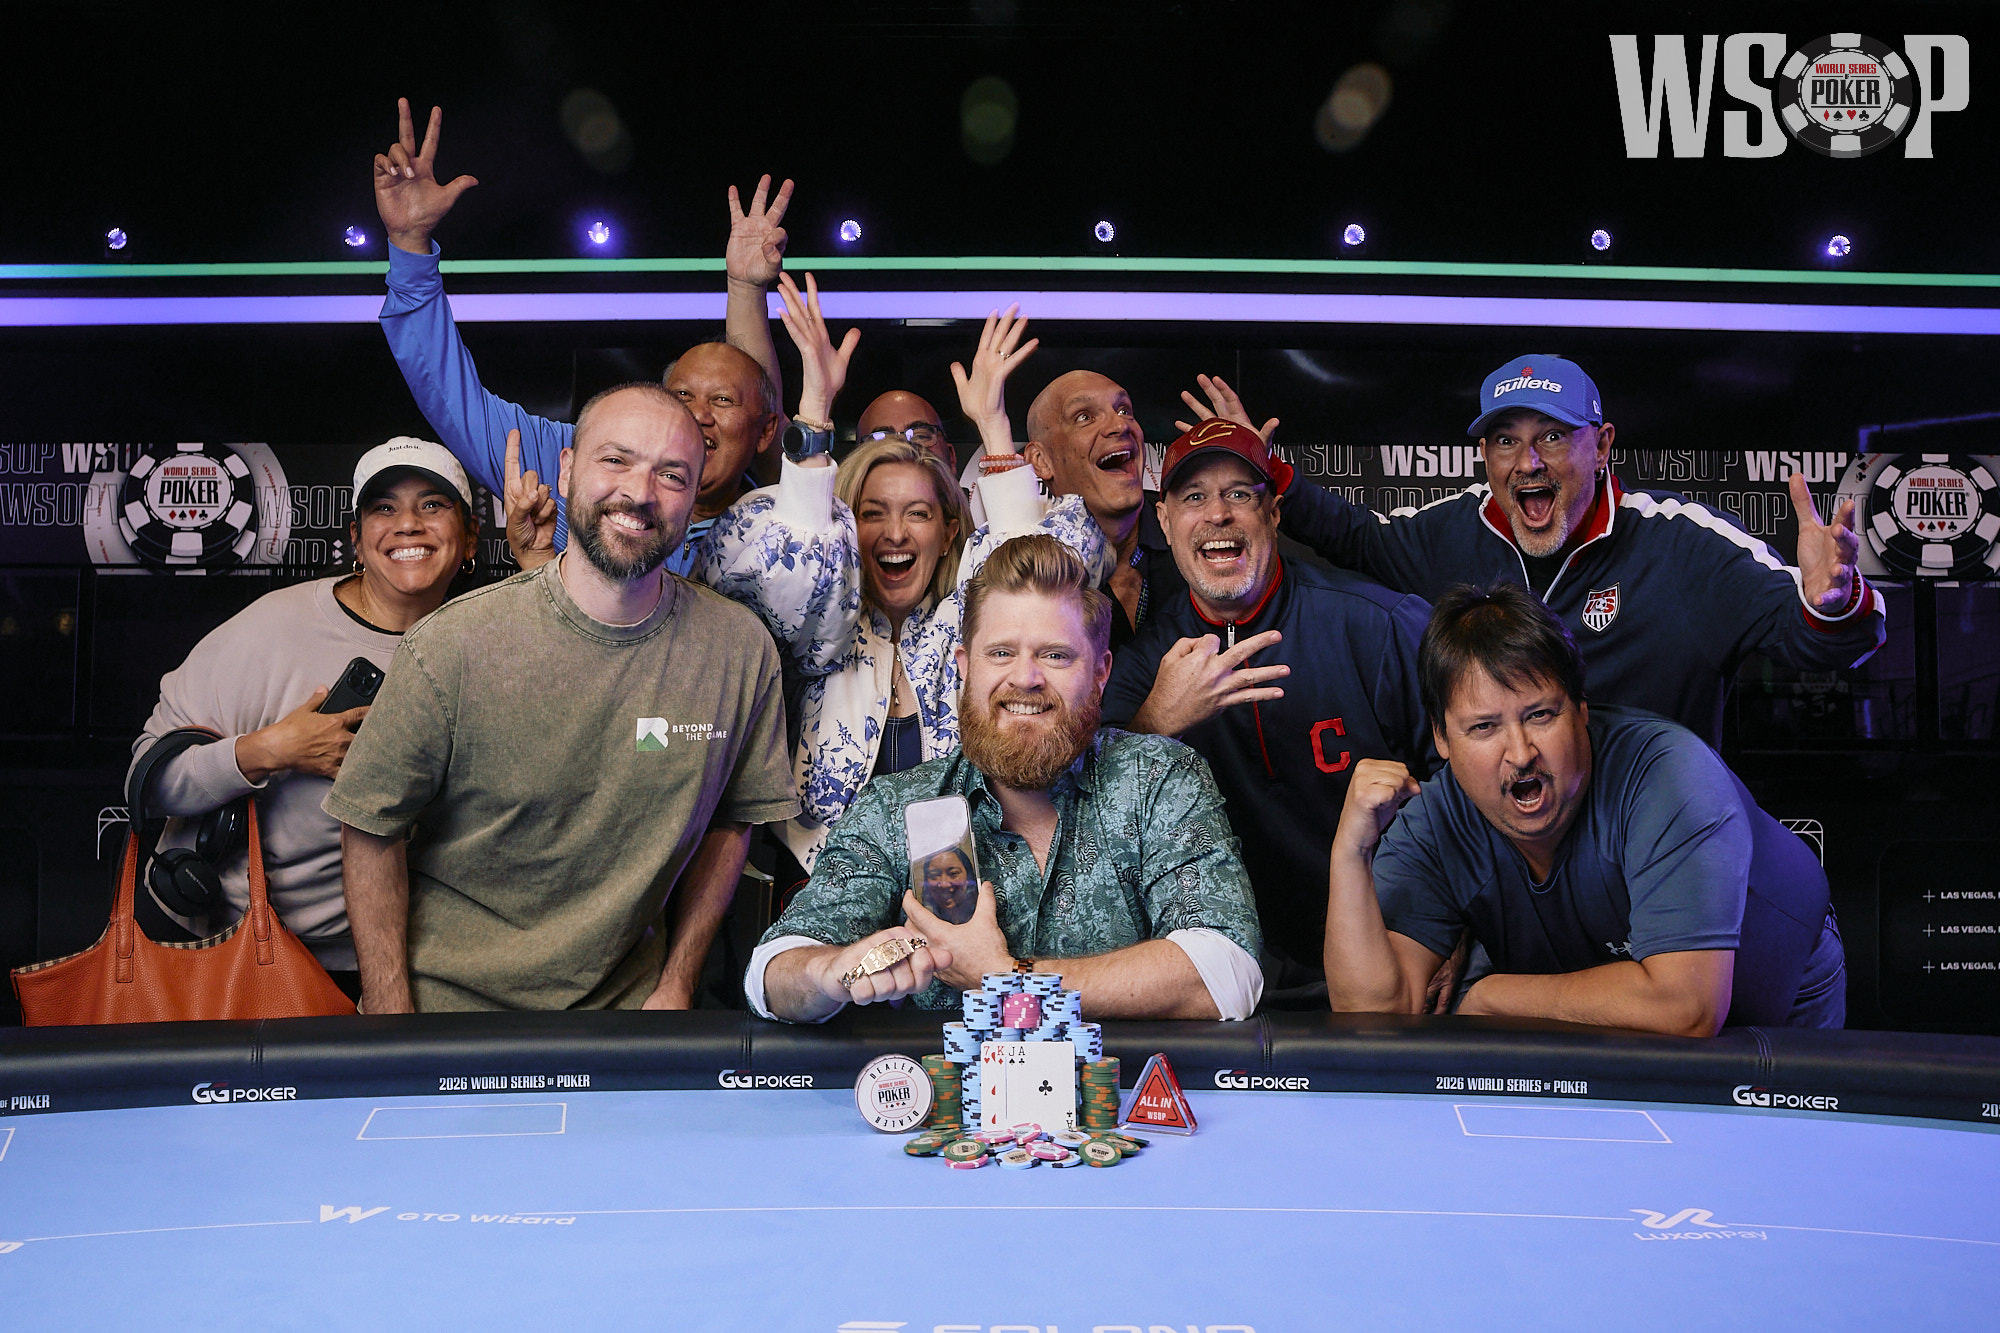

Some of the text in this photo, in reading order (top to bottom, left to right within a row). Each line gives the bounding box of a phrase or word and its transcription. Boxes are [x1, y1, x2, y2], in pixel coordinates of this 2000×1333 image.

[1494, 375, 1562, 398] bullets
[62, 442, 153, 474] WSO
[1380, 444, 1485, 478] WSOP
[1634, 449, 1739, 482] WSOP
[1744, 450, 1848, 482] WSOP
[164, 466, 217, 476] WORLD SERIES
[1909, 478, 1964, 488] WORLD SERIES
[159, 480, 218, 504] POKER
[0, 483, 101, 526] WSOP
[254, 485, 354, 529] WSOP
[1906, 492, 1968, 516] POKER
[672, 724, 714, 733] BEYOND
[686, 733, 702, 741] THE
[1310, 718, 1351, 774] C
[1961, 892, 1996, 900] VEGAS,
[1961, 926, 1996, 934] VEGAS,
[1961, 962, 1996, 971] VEGAS,
[984, 1046, 1025, 1056] 7 K J A
[870, 1062, 914, 1080] DEALER
[439, 1077, 467, 1090] 2026
[471, 1076, 507, 1090] WORLD
[510, 1075, 545, 1089] SERIES
[556, 1074, 590, 1088] POKER
[1436, 1077, 1464, 1090] 2026
[1467, 1078, 1504, 1091] WORLD
[1506, 1078, 1542, 1092] SERIES
[1553, 1080, 1588, 1094] POKER
[11, 1095, 50, 1110] POKER
[878, 1087, 910, 1103] POKER
[1139, 1096, 1172, 1108] ALL IN
[1147, 1111, 1166, 1120] WSOP
[1982, 1103, 2000, 1117] 20
[396, 1212, 460, 1222] GTO
[470, 1214, 576, 1225] Wizard
